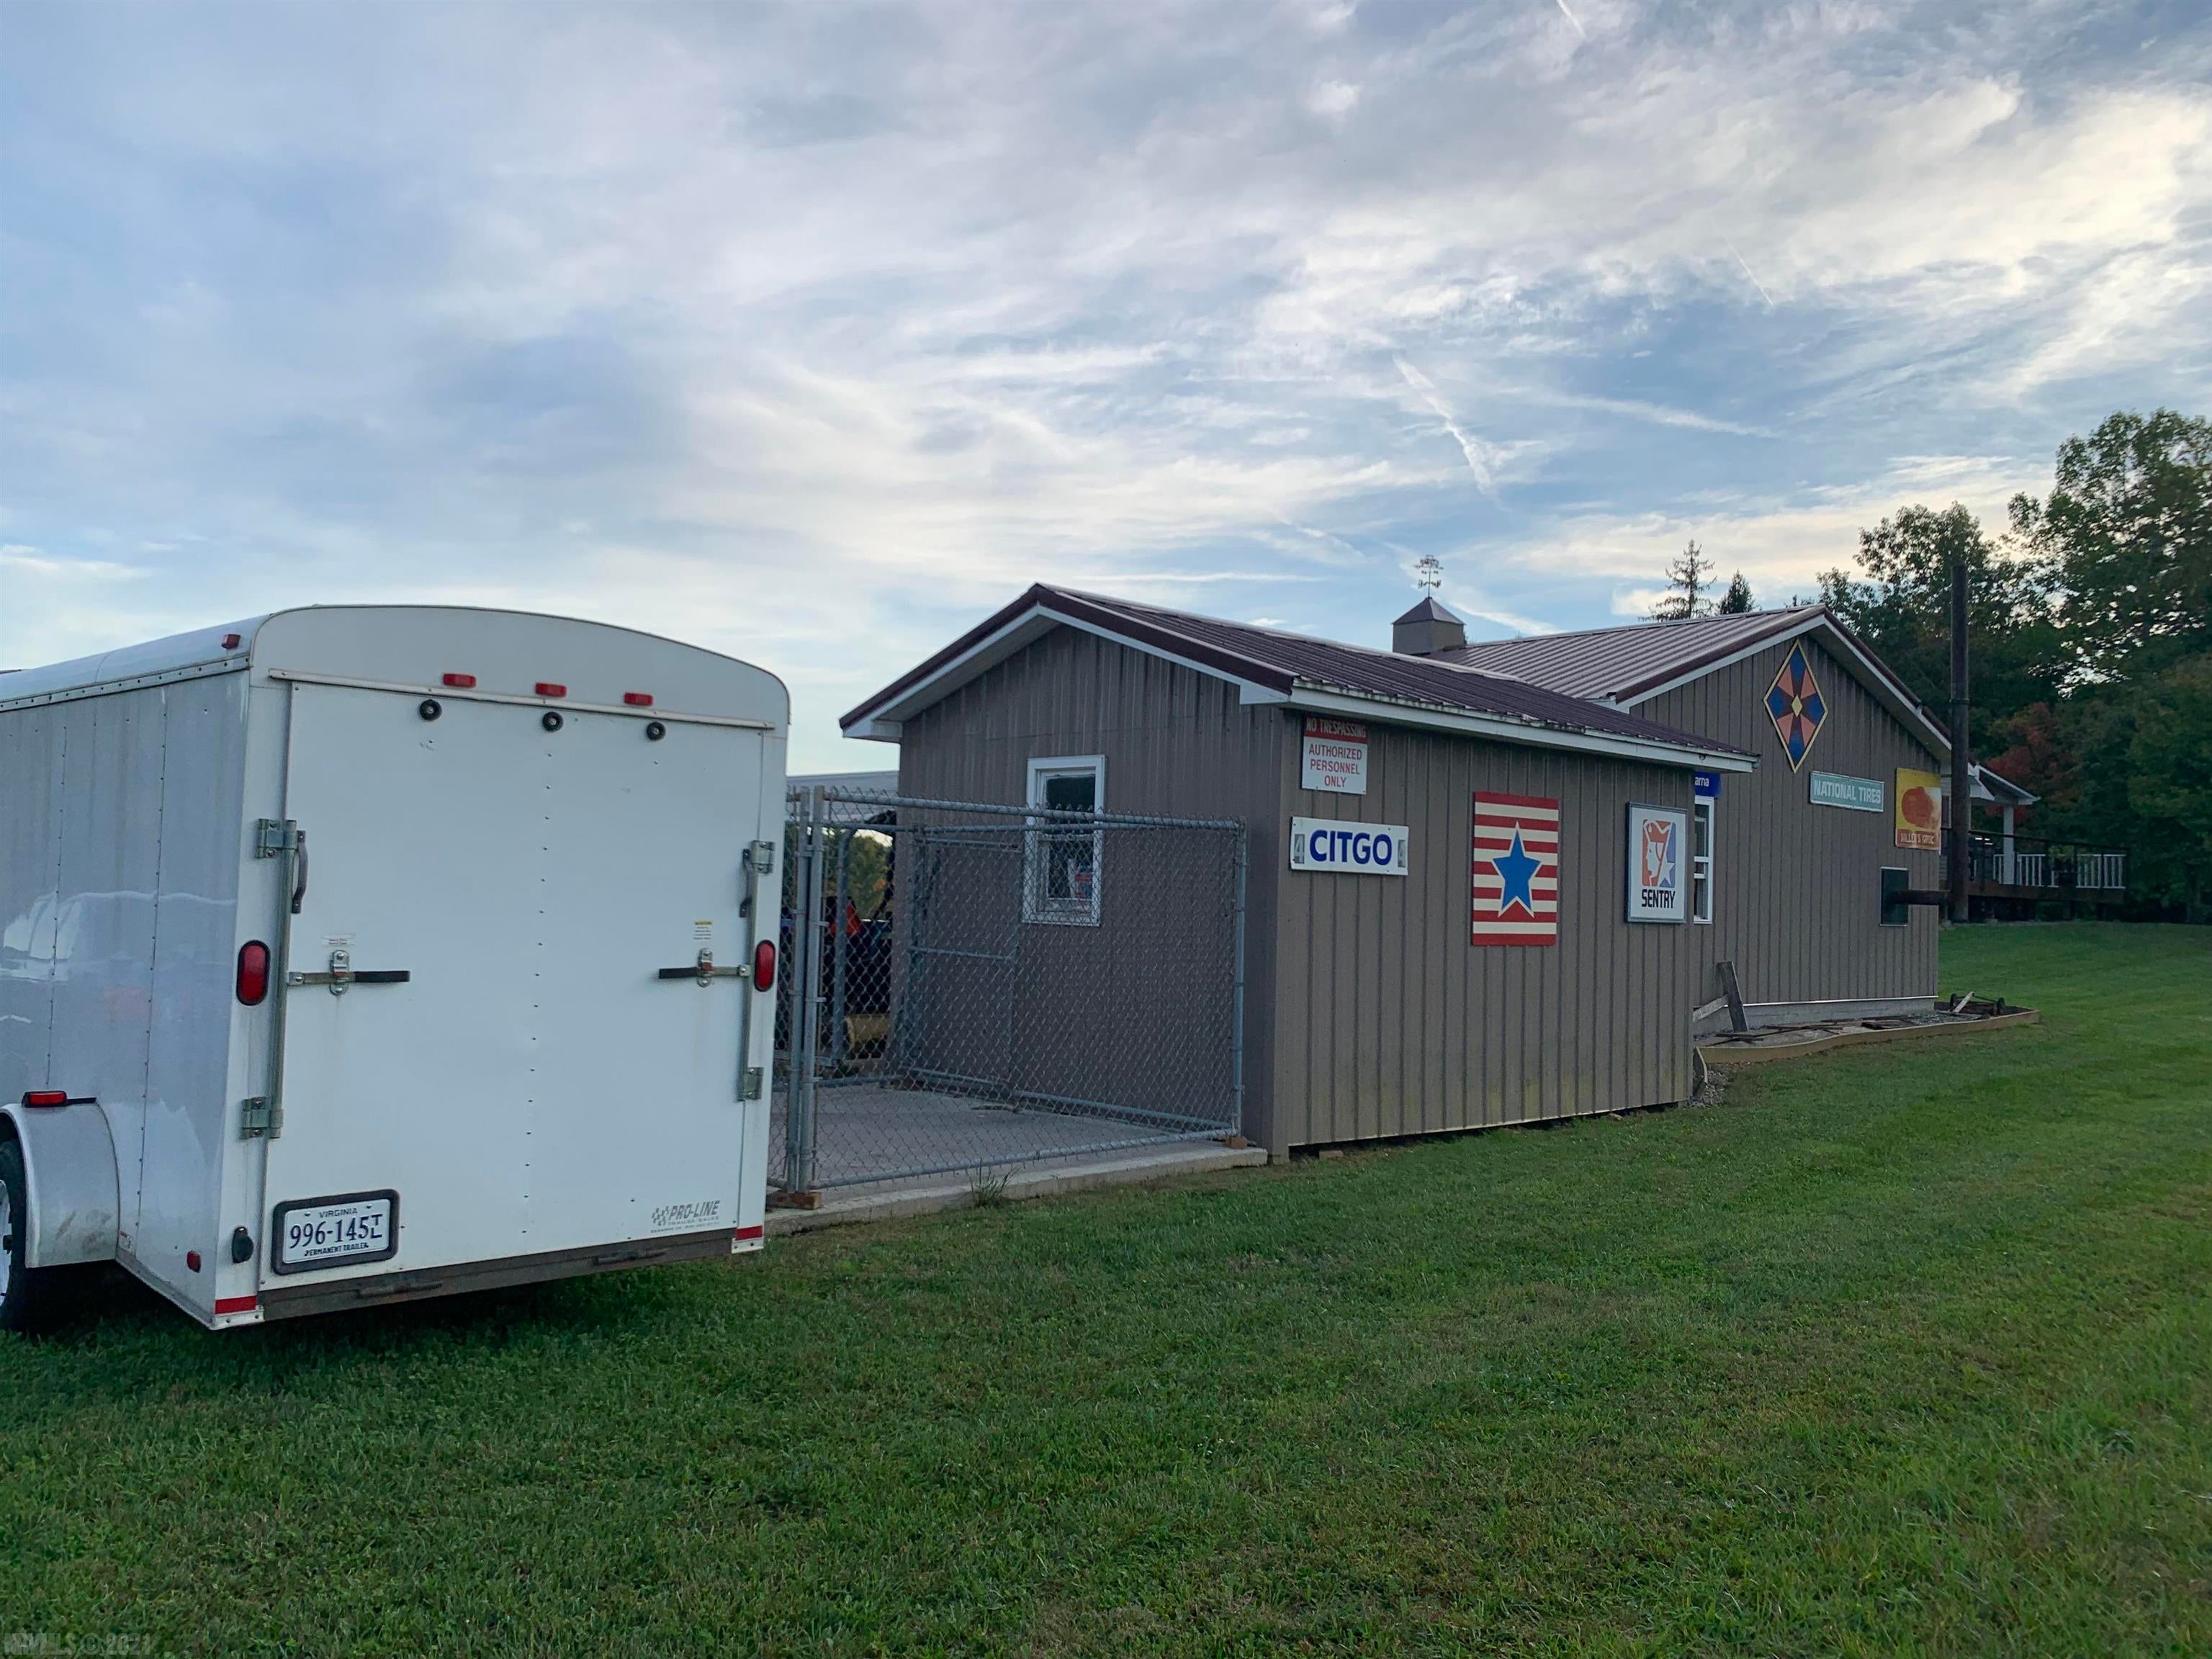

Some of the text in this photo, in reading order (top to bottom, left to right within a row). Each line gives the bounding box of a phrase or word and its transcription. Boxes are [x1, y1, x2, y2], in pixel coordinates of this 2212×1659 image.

[1306, 718, 1367, 738] NO TRESPASSING
[1309, 744, 1362, 760] AUTHORIZED
[1310, 759, 1360, 775] PERSONNEL
[1324, 775, 1347, 788] ONLY
[1813, 779, 1881, 804] NATIONAL TIRES
[1310, 830, 1393, 866] CITGO
[1641, 889, 1676, 909] SENTRY
[319, 1208, 358, 1218] VIRGINIA
[669, 1200, 720, 1221] PRO-LINE
[289, 1216, 369, 1249] 996-145
[304, 1242, 369, 1256] PERMANENT TRAILER
